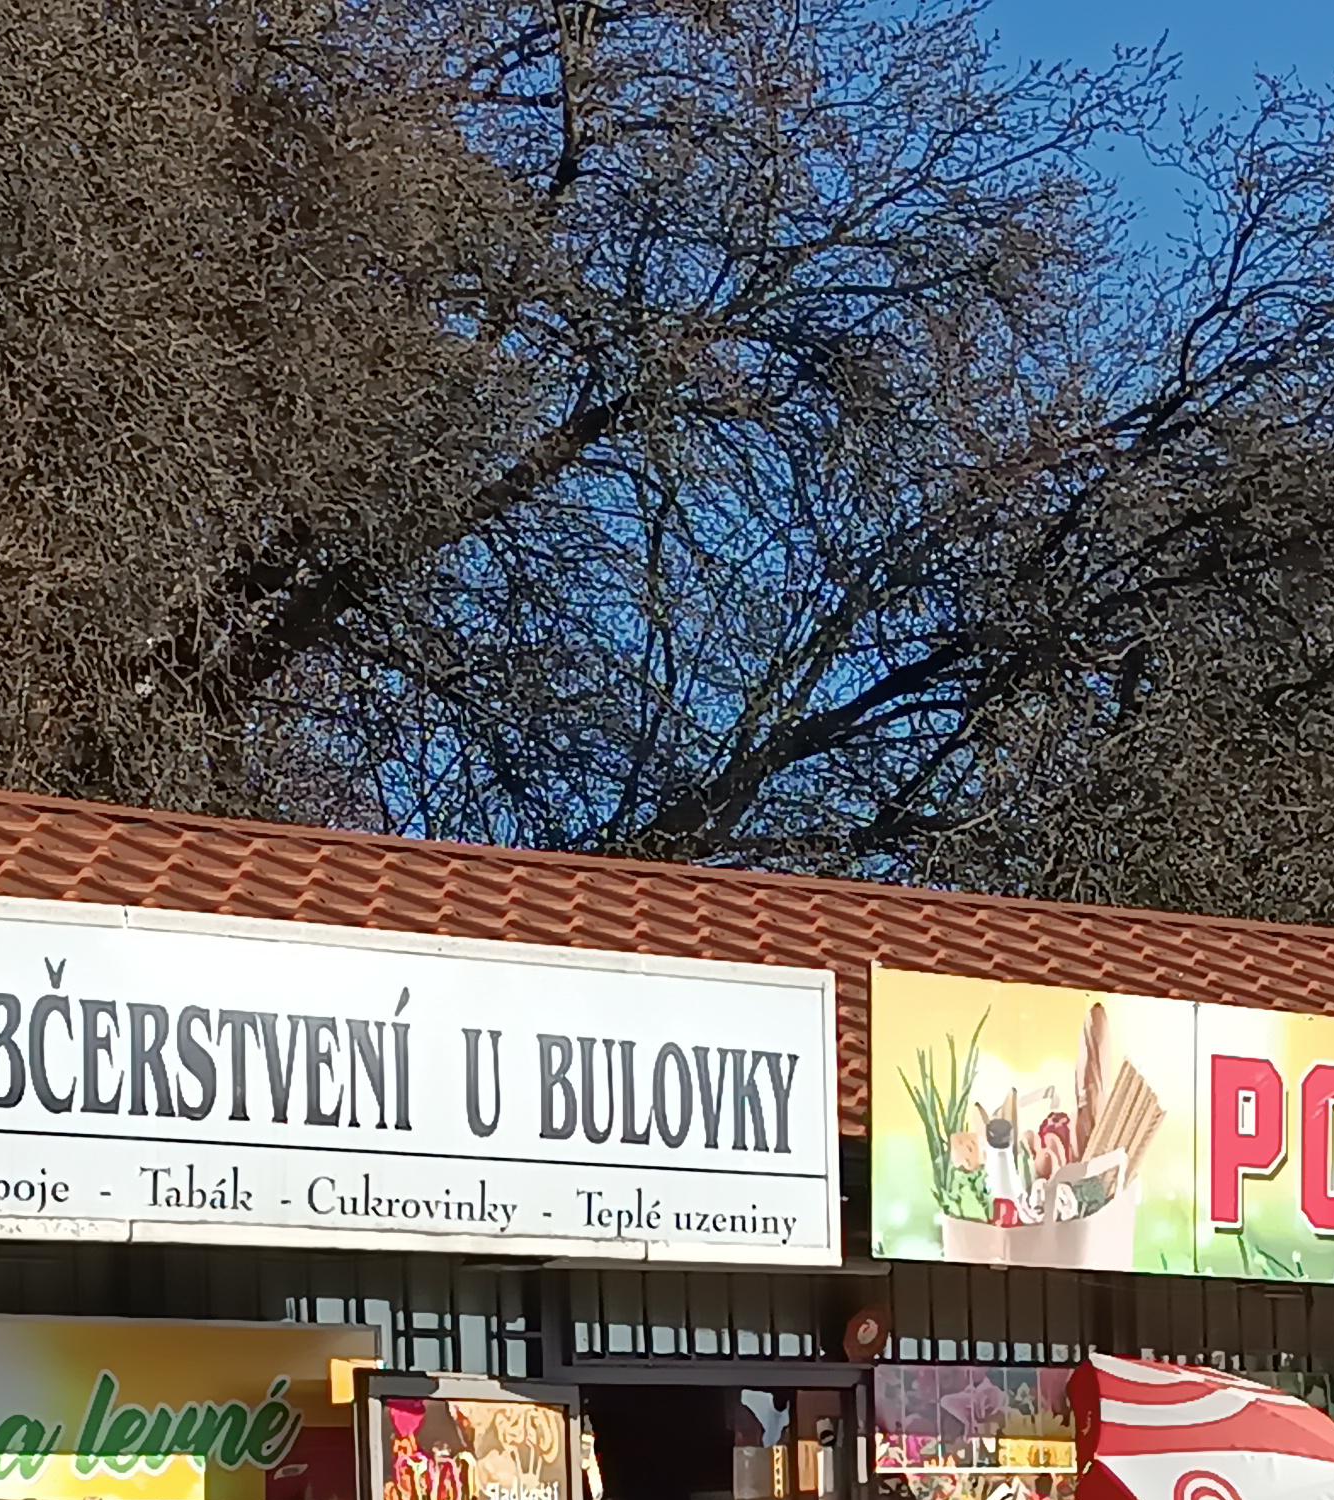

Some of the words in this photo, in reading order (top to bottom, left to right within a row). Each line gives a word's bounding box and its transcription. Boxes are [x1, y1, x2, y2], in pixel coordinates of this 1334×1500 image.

[462, 1028, 502, 1137] U
[536, 1033, 799, 1154] BULOVKY
[140, 1164, 253, 1212] Tabák
[307, 1174, 518, 1233] Cukrovinky
[577, 1188, 662, 1237] Teplé
[674, 1205, 798, 1245] uzeniny
[75, 1370, 304, 1474] levné
